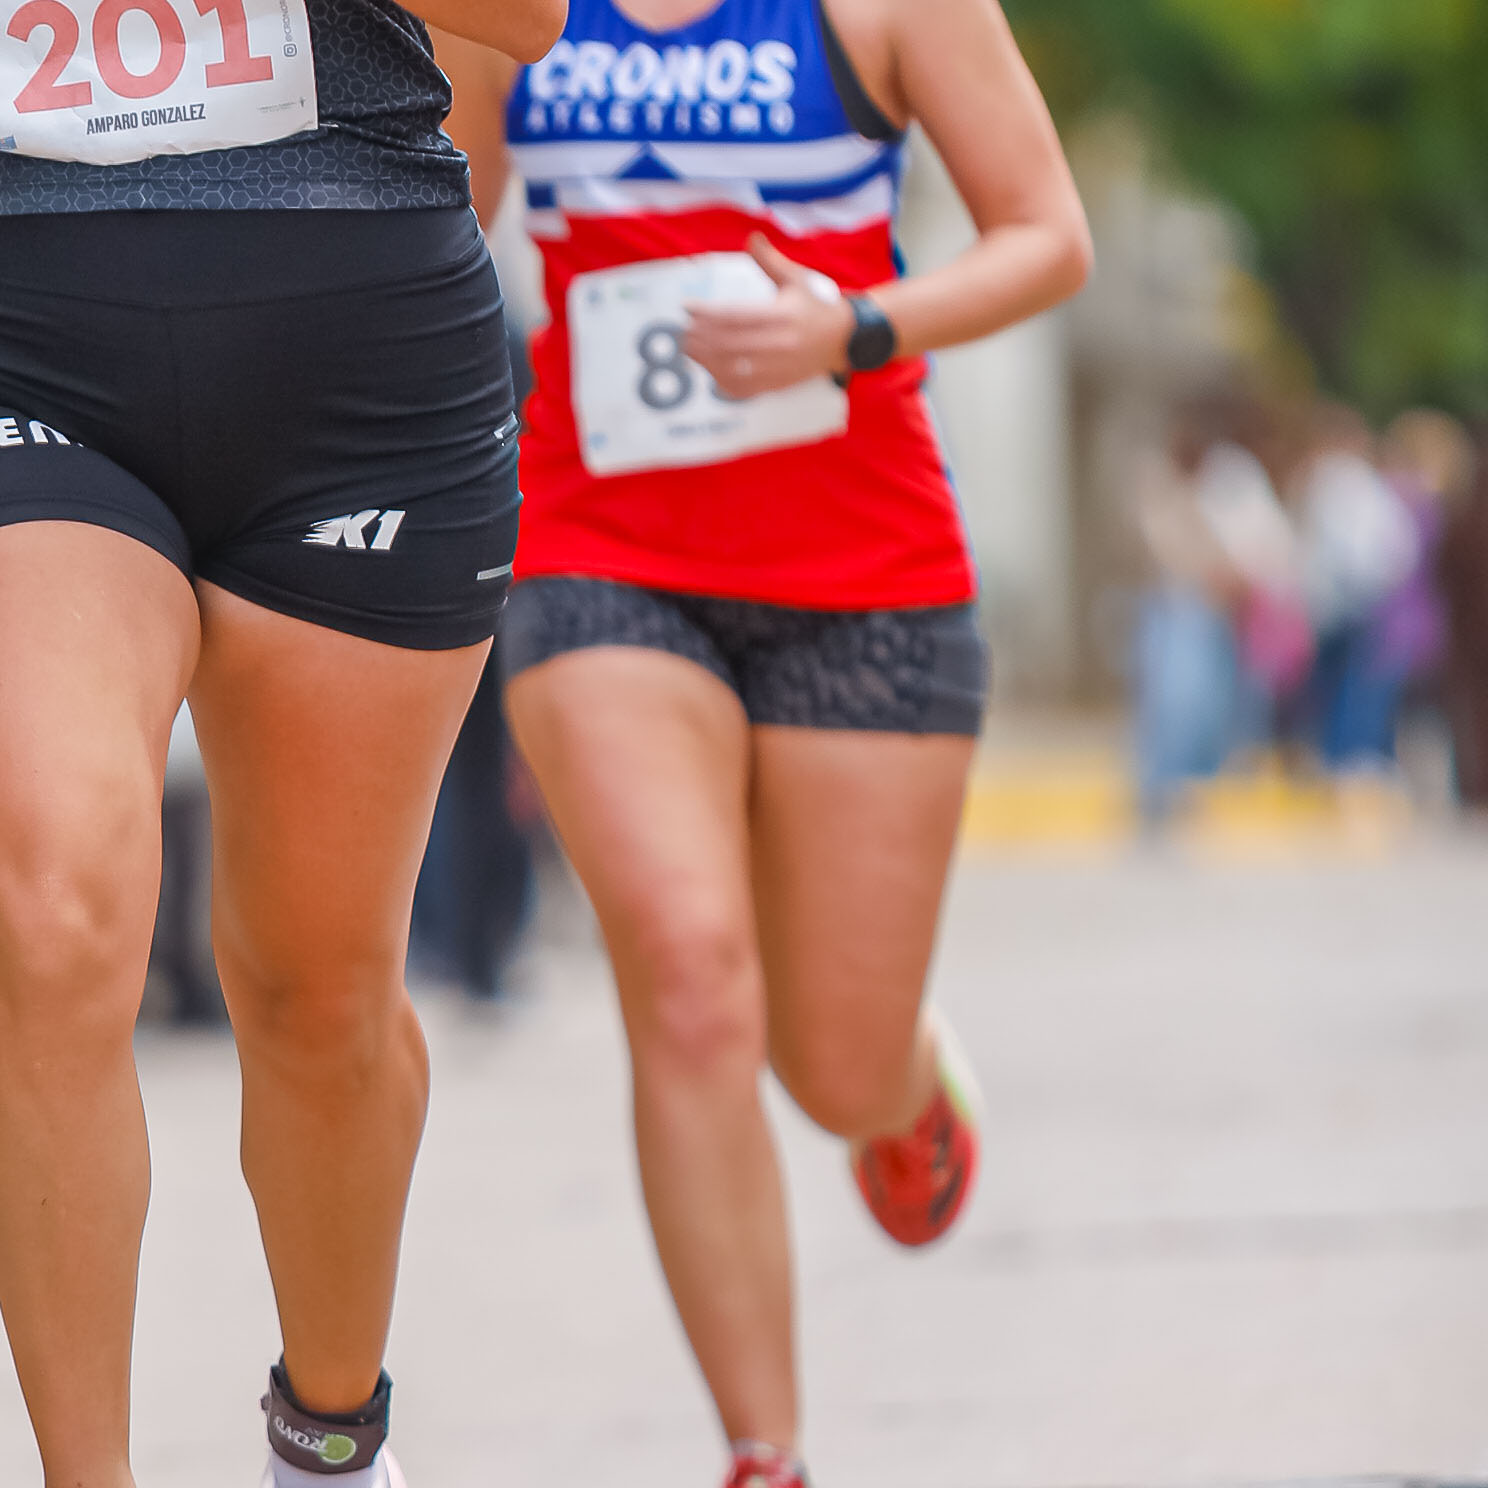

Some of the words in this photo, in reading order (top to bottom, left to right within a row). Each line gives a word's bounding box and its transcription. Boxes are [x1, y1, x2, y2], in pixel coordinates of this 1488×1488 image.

[528, 39, 798, 104] CRONOS
[87, 112, 138, 135] AMPARO
[141, 103, 206, 127] GONZALEZ
